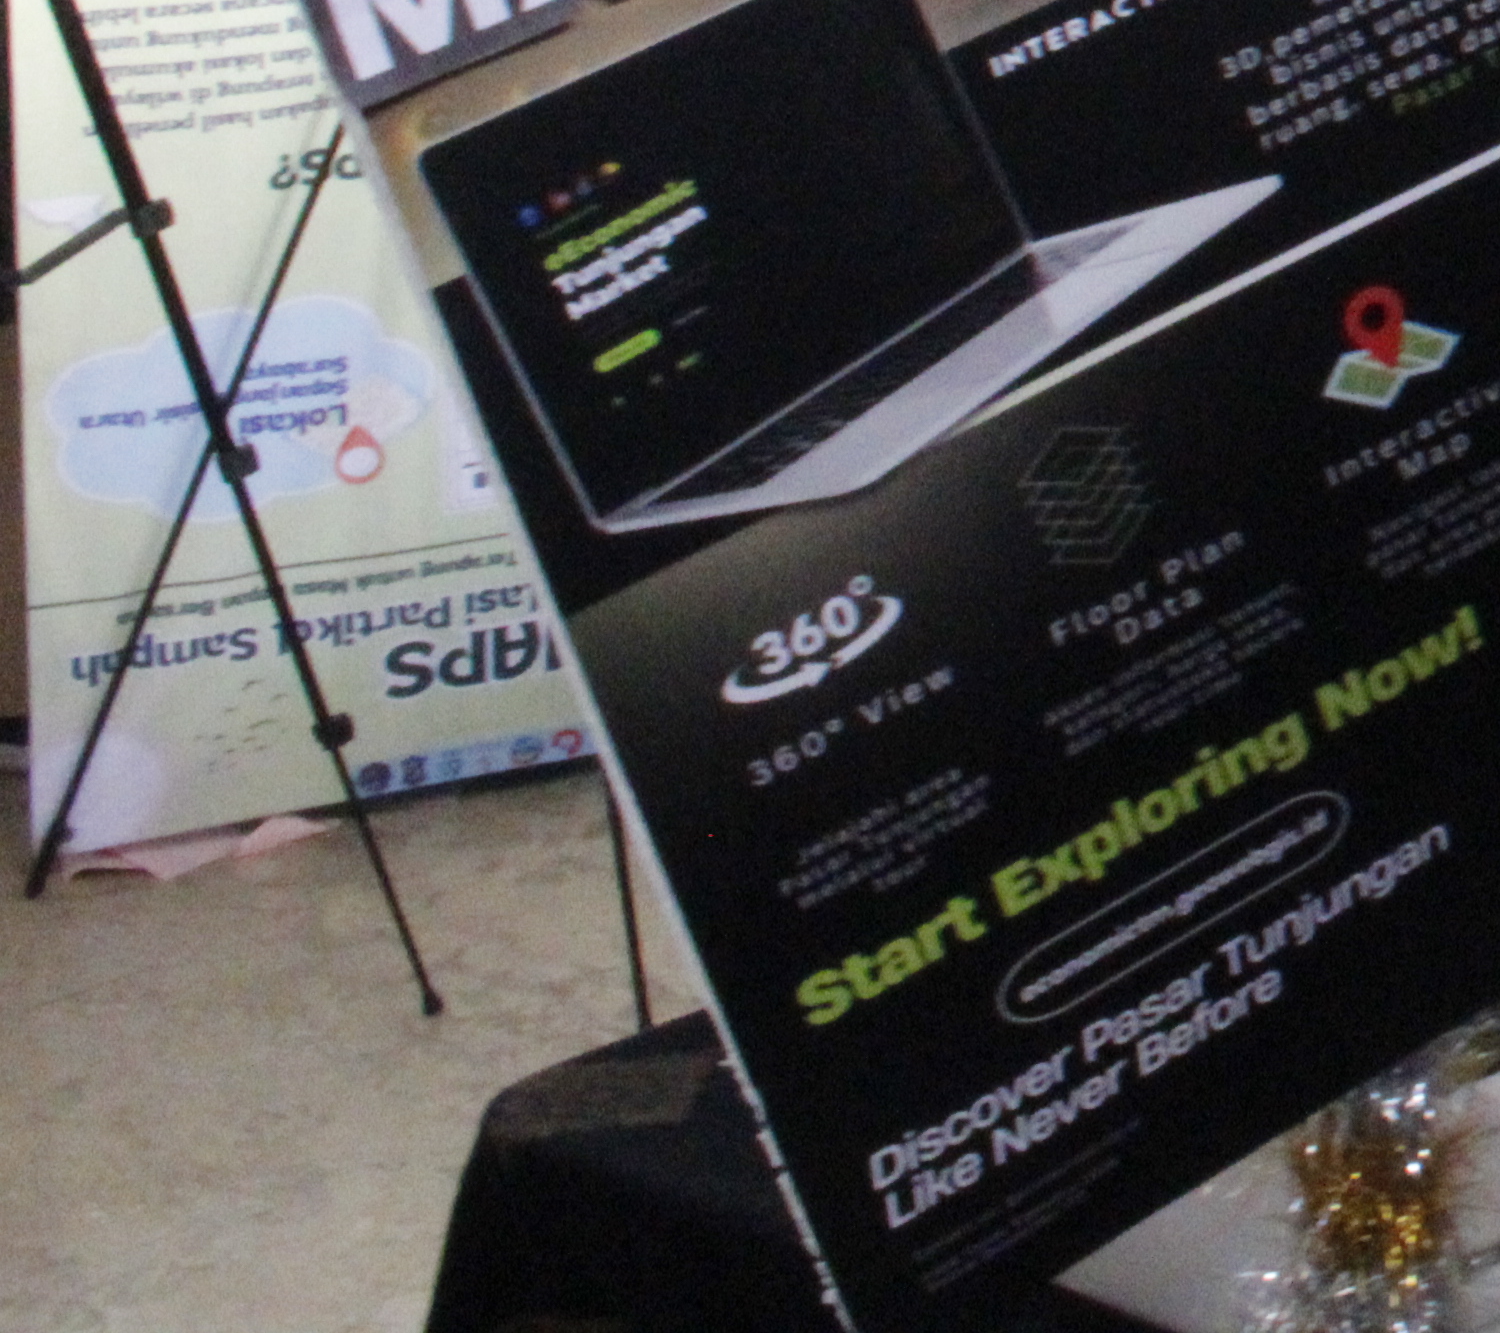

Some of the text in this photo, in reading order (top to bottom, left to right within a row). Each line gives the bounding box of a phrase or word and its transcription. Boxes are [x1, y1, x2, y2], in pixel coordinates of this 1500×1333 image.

[1247, 51, 1381, 126] berbasis
[1390, 14, 1459, 58] data
[1269, 29, 1365, 85] bisnis
[239, 404, 348, 436] Lokasi
[1396, 431, 1472, 480] Map
[751, 574, 891, 676] 360°
[1048, 529, 1245, 646] Floor Plan
[1114, 586, 1203, 645] Data
[748, 665, 955, 787] 360° View
[796, 896, 986, 1026] Start
[991, 714, 1310, 917] Exploring
[1314, 606, 1483, 729] Now!
[867, 824, 1452, 1190] Discover Pasar Tunjungan
[882, 1151, 984, 1229] Like
[989, 1063, 1124, 1164] Never
[1134, 969, 1284, 1075] Before
